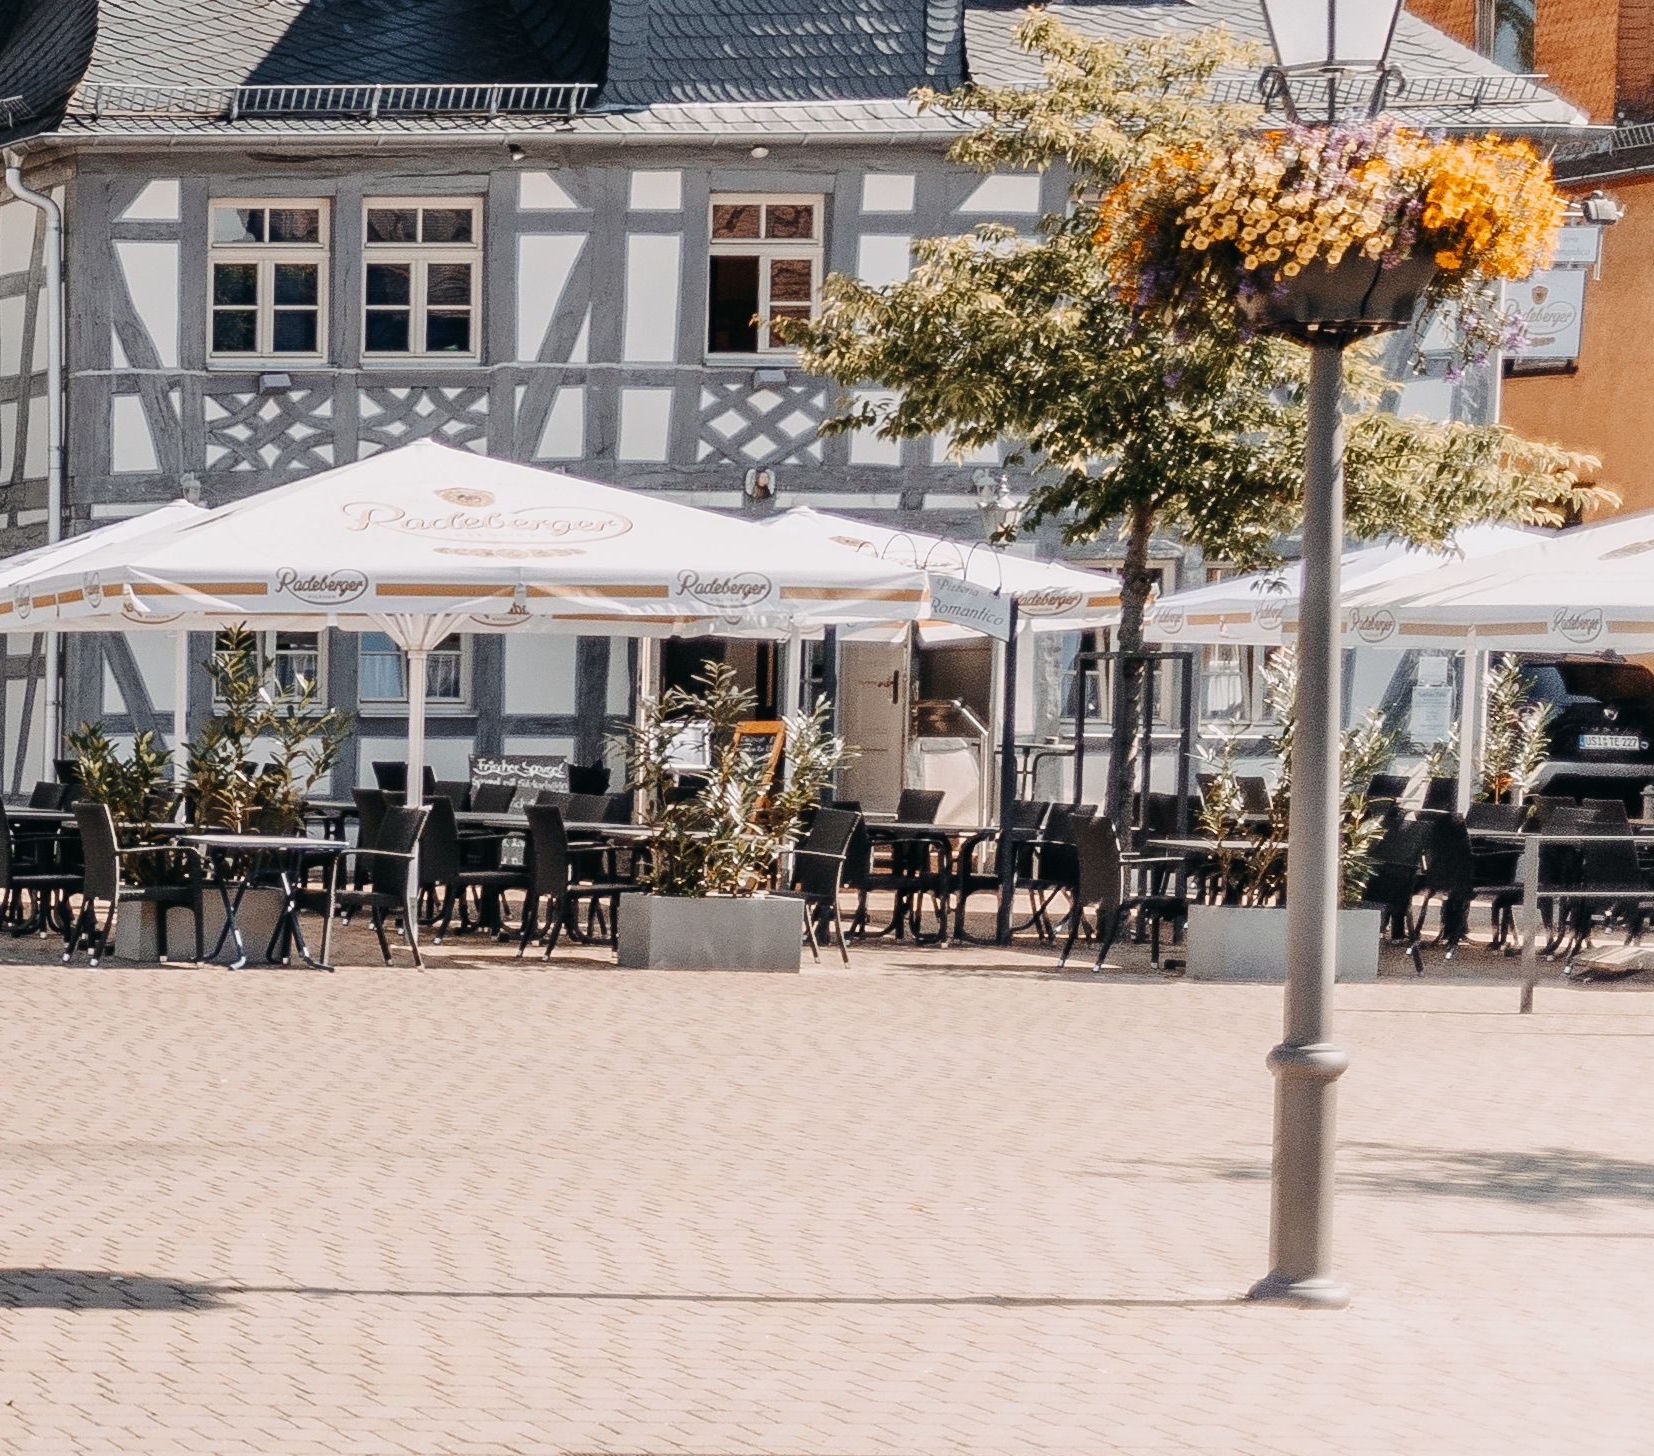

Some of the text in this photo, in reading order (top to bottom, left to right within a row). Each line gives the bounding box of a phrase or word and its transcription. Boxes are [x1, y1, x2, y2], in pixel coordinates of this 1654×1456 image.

[341, 501, 621, 537] Radeberger
[275, 566, 365, 598] Radeberger
[676, 569, 768, 601] Radeberger
[930, 596, 1004, 626] Romantico
